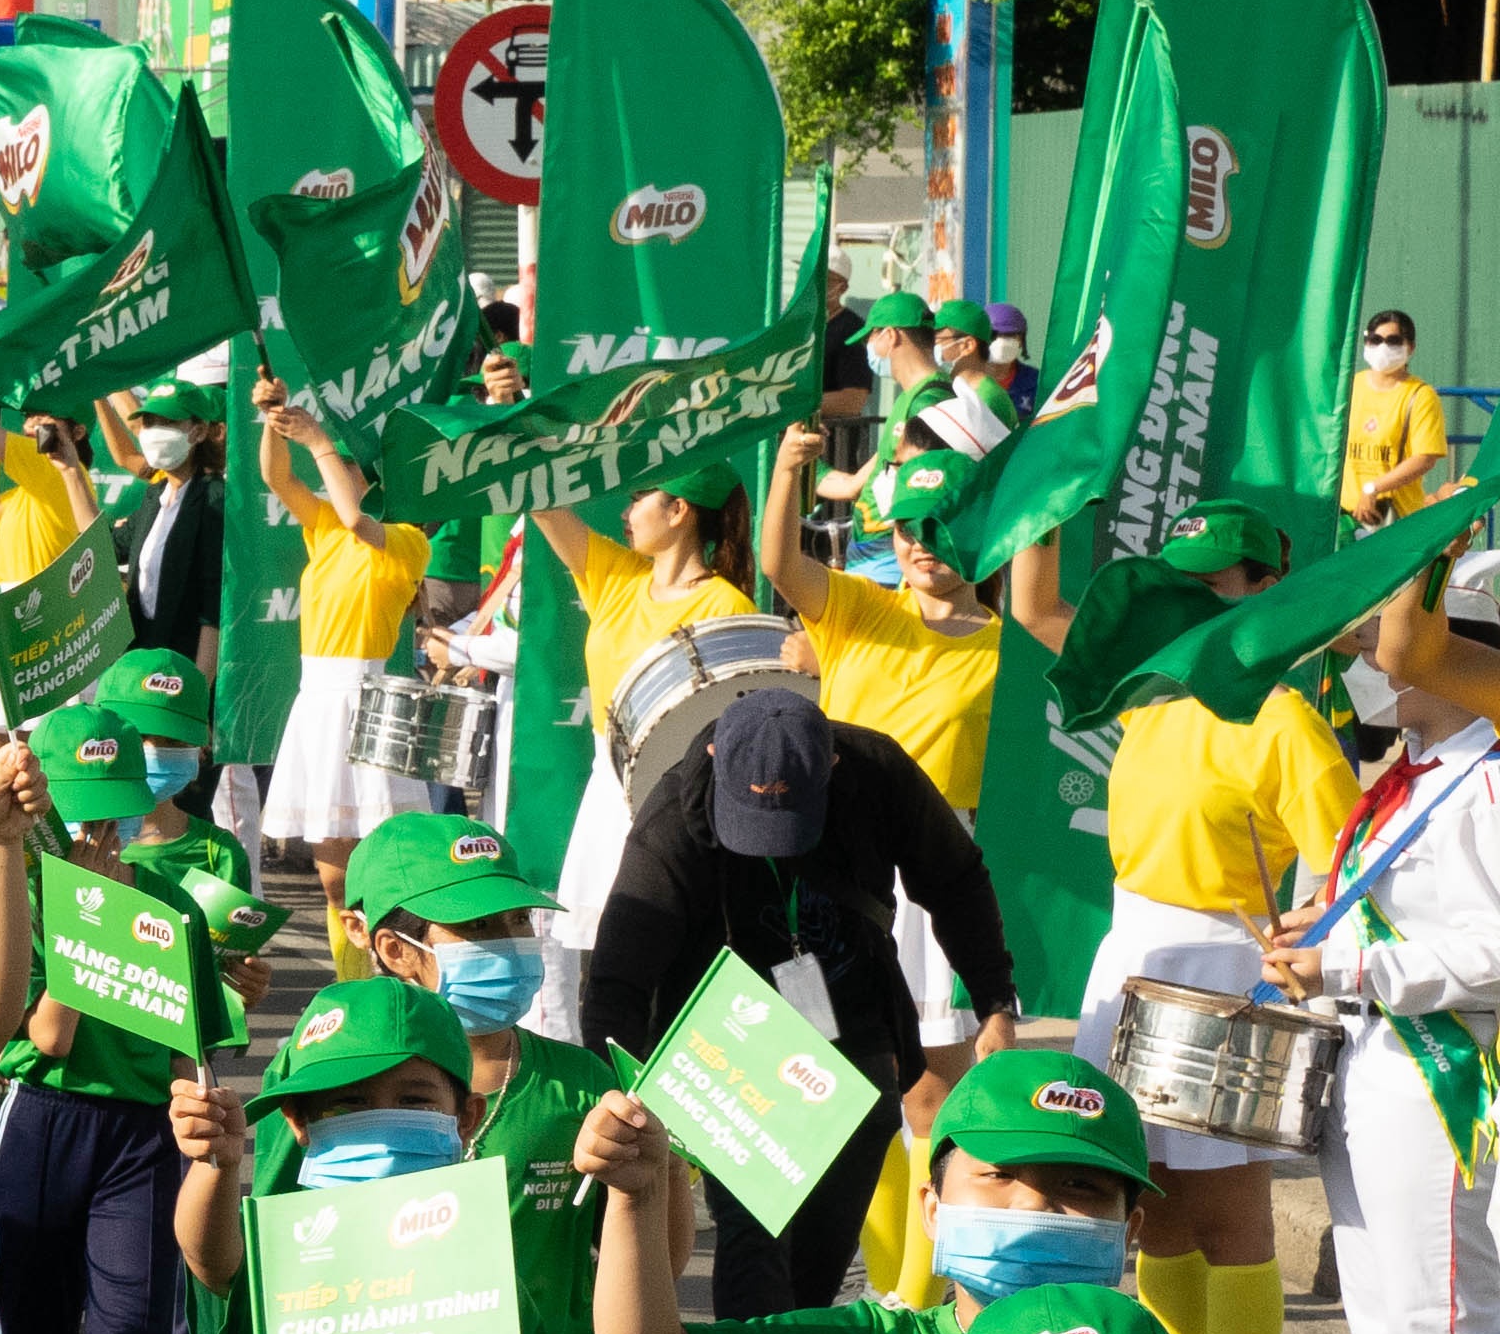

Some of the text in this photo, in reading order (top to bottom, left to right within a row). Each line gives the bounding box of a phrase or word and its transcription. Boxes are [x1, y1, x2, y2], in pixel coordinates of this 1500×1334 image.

[1187, 135, 1219, 232] MILO
[625, 201, 697, 231] MILO
[82, 288, 170, 359] NAM
[9, 639, 49, 668] TIẾP
[63, 613, 87, 638] CHÍ
[13, 659, 52, 686] CHO
[52, 636, 89, 669] HÀNH
[18, 643, 102, 706] NĂNG ĐỘNG
[138, 921, 171, 944] MILO
[53, 932, 190, 1006] NĂNG ĐỘNG
[69, 962, 187, 1026] VIỆT NAM
[686, 1029, 729, 1072] TIẾP
[656, 1070, 752, 1167] NĂNG ĐỘNG
[672, 1051, 807, 1186] CHO HÀNH TRÌNH
[1045, 1088, 1103, 1113] MILO
[275, 1283, 336, 1315] TIẾP
[368, 1269, 415, 1302] CHÍ
[423, 1286, 501, 1324] TRÌNH
